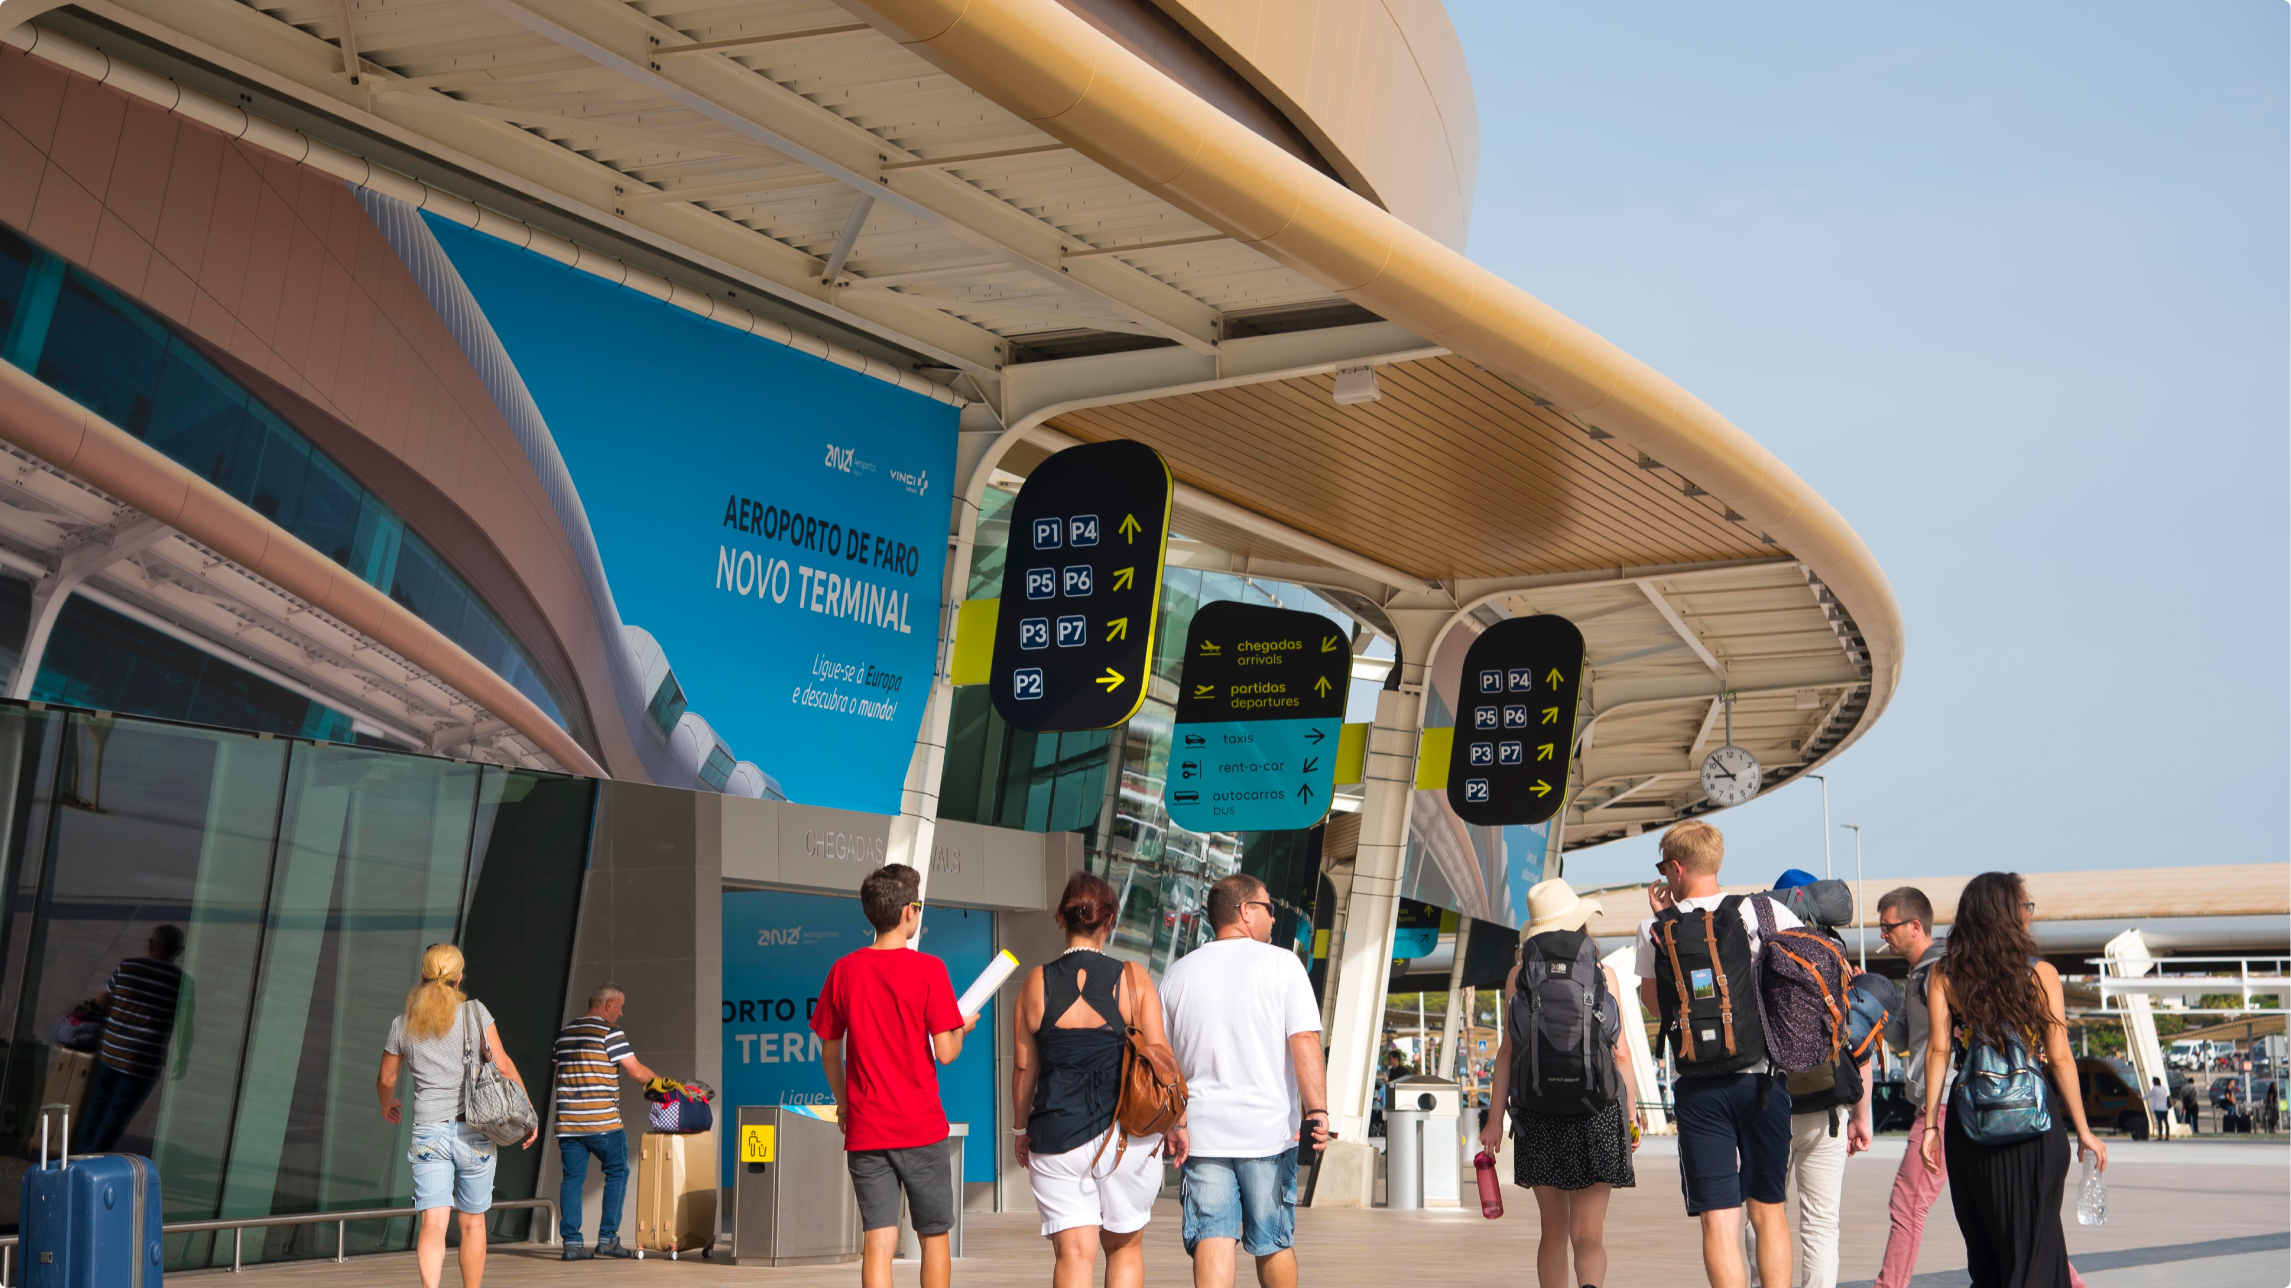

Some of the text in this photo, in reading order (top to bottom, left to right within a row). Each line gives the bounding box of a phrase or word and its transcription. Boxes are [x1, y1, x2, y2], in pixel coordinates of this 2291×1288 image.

[890, 469, 916, 486] VINCI
[723, 495, 918, 577] AEROPORTO DE FARO
[1037, 521, 1097, 544] P1 P4
[716, 545, 912, 634] NOVO TERMINAL
[1028, 571, 1090, 594] P5 P6
[1022, 621, 1084, 644] P3 P7
[1238, 639, 1302, 654] chegadas
[1238, 654, 1282, 666] arrivals
[812, 654, 902, 695] Ligue-se à Europa
[1483, 673, 1529, 689] P1 P4
[1016, 674, 1041, 694] P2
[1230, 682, 1286, 697] partidas
[792, 682, 898, 722] e descubra o mundo!
[1230, 697, 1300, 710] departures
[1476, 709, 1524, 725] P5 P6
[1223, 732, 1254, 744] taxis
[1472, 746, 1520, 761] P3 P7
[1219, 762, 1284, 773] rent-a-car
[1212, 790, 1284, 802] autocarros
[1468, 783, 1486, 798] P2
[1214, 805, 1236, 816] bus
[806, 828, 884, 864] CHEGADAS
